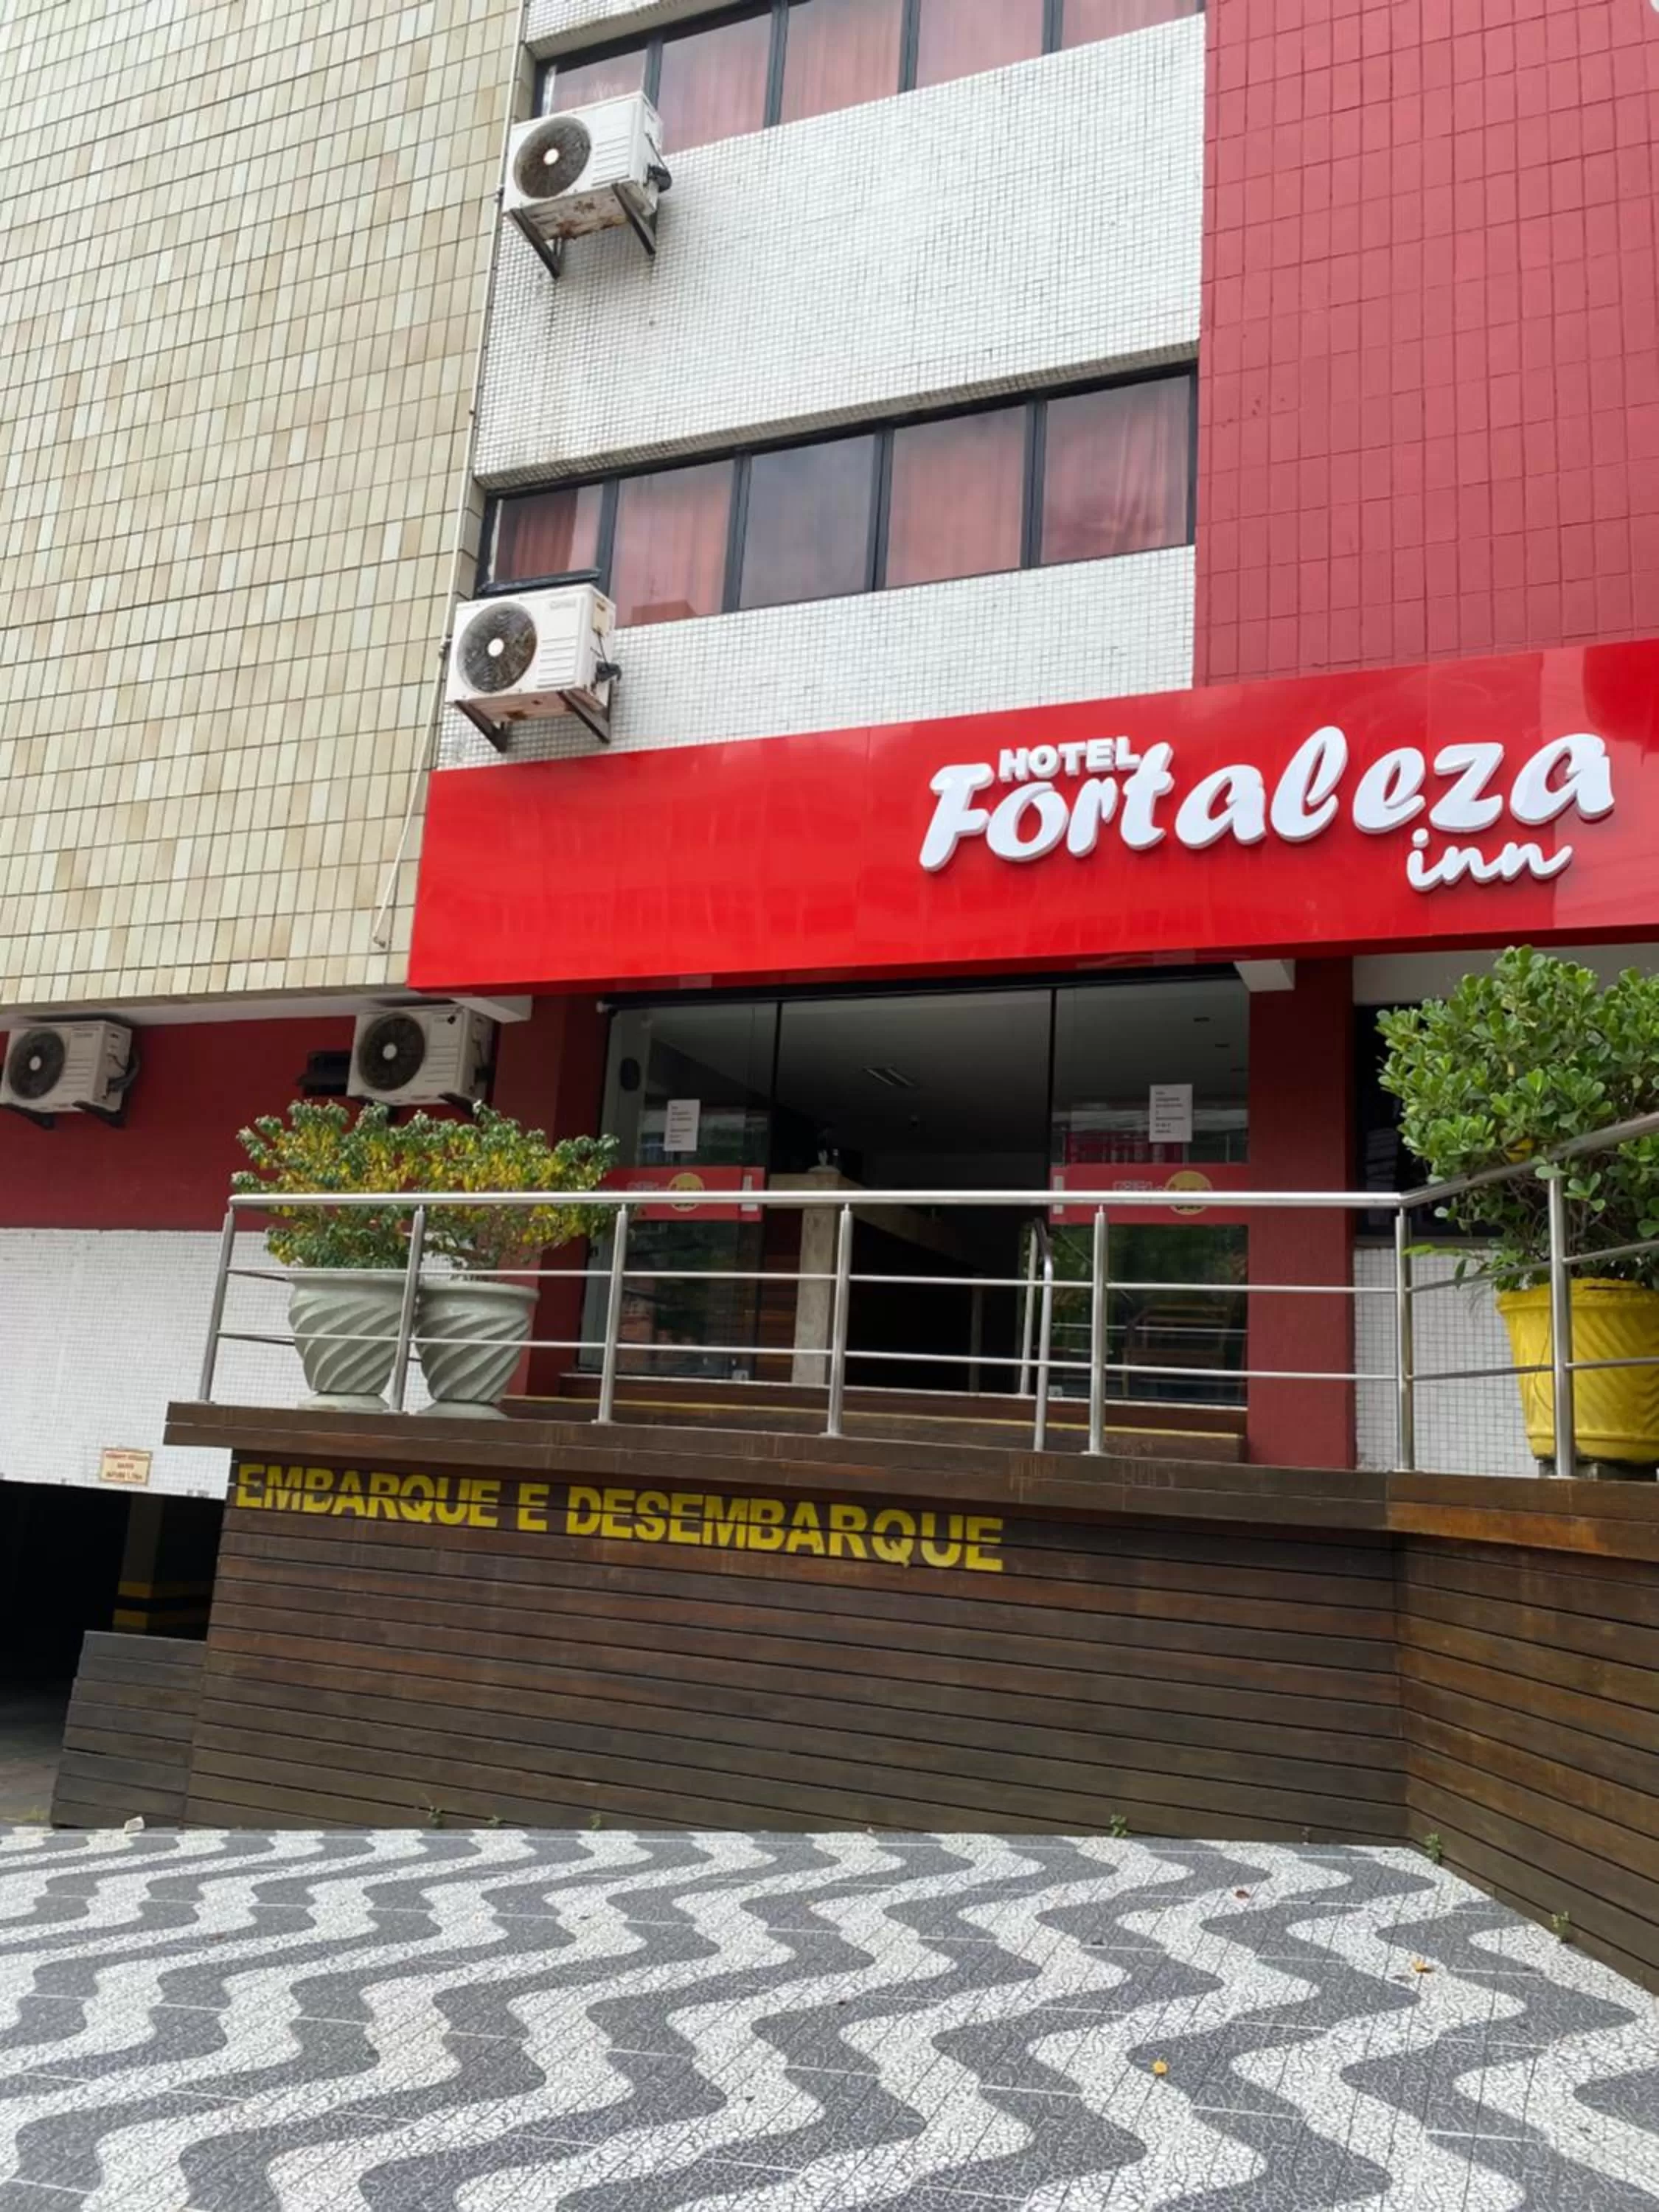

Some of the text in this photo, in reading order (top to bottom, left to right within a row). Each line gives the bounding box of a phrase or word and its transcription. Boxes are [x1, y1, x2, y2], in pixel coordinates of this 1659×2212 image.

[999, 737, 1143, 782] HOTEL
[1407, 829, 1573, 891] inn
[235, 1464, 1004, 1573] EMBARQUE E DESEMBARQUE
